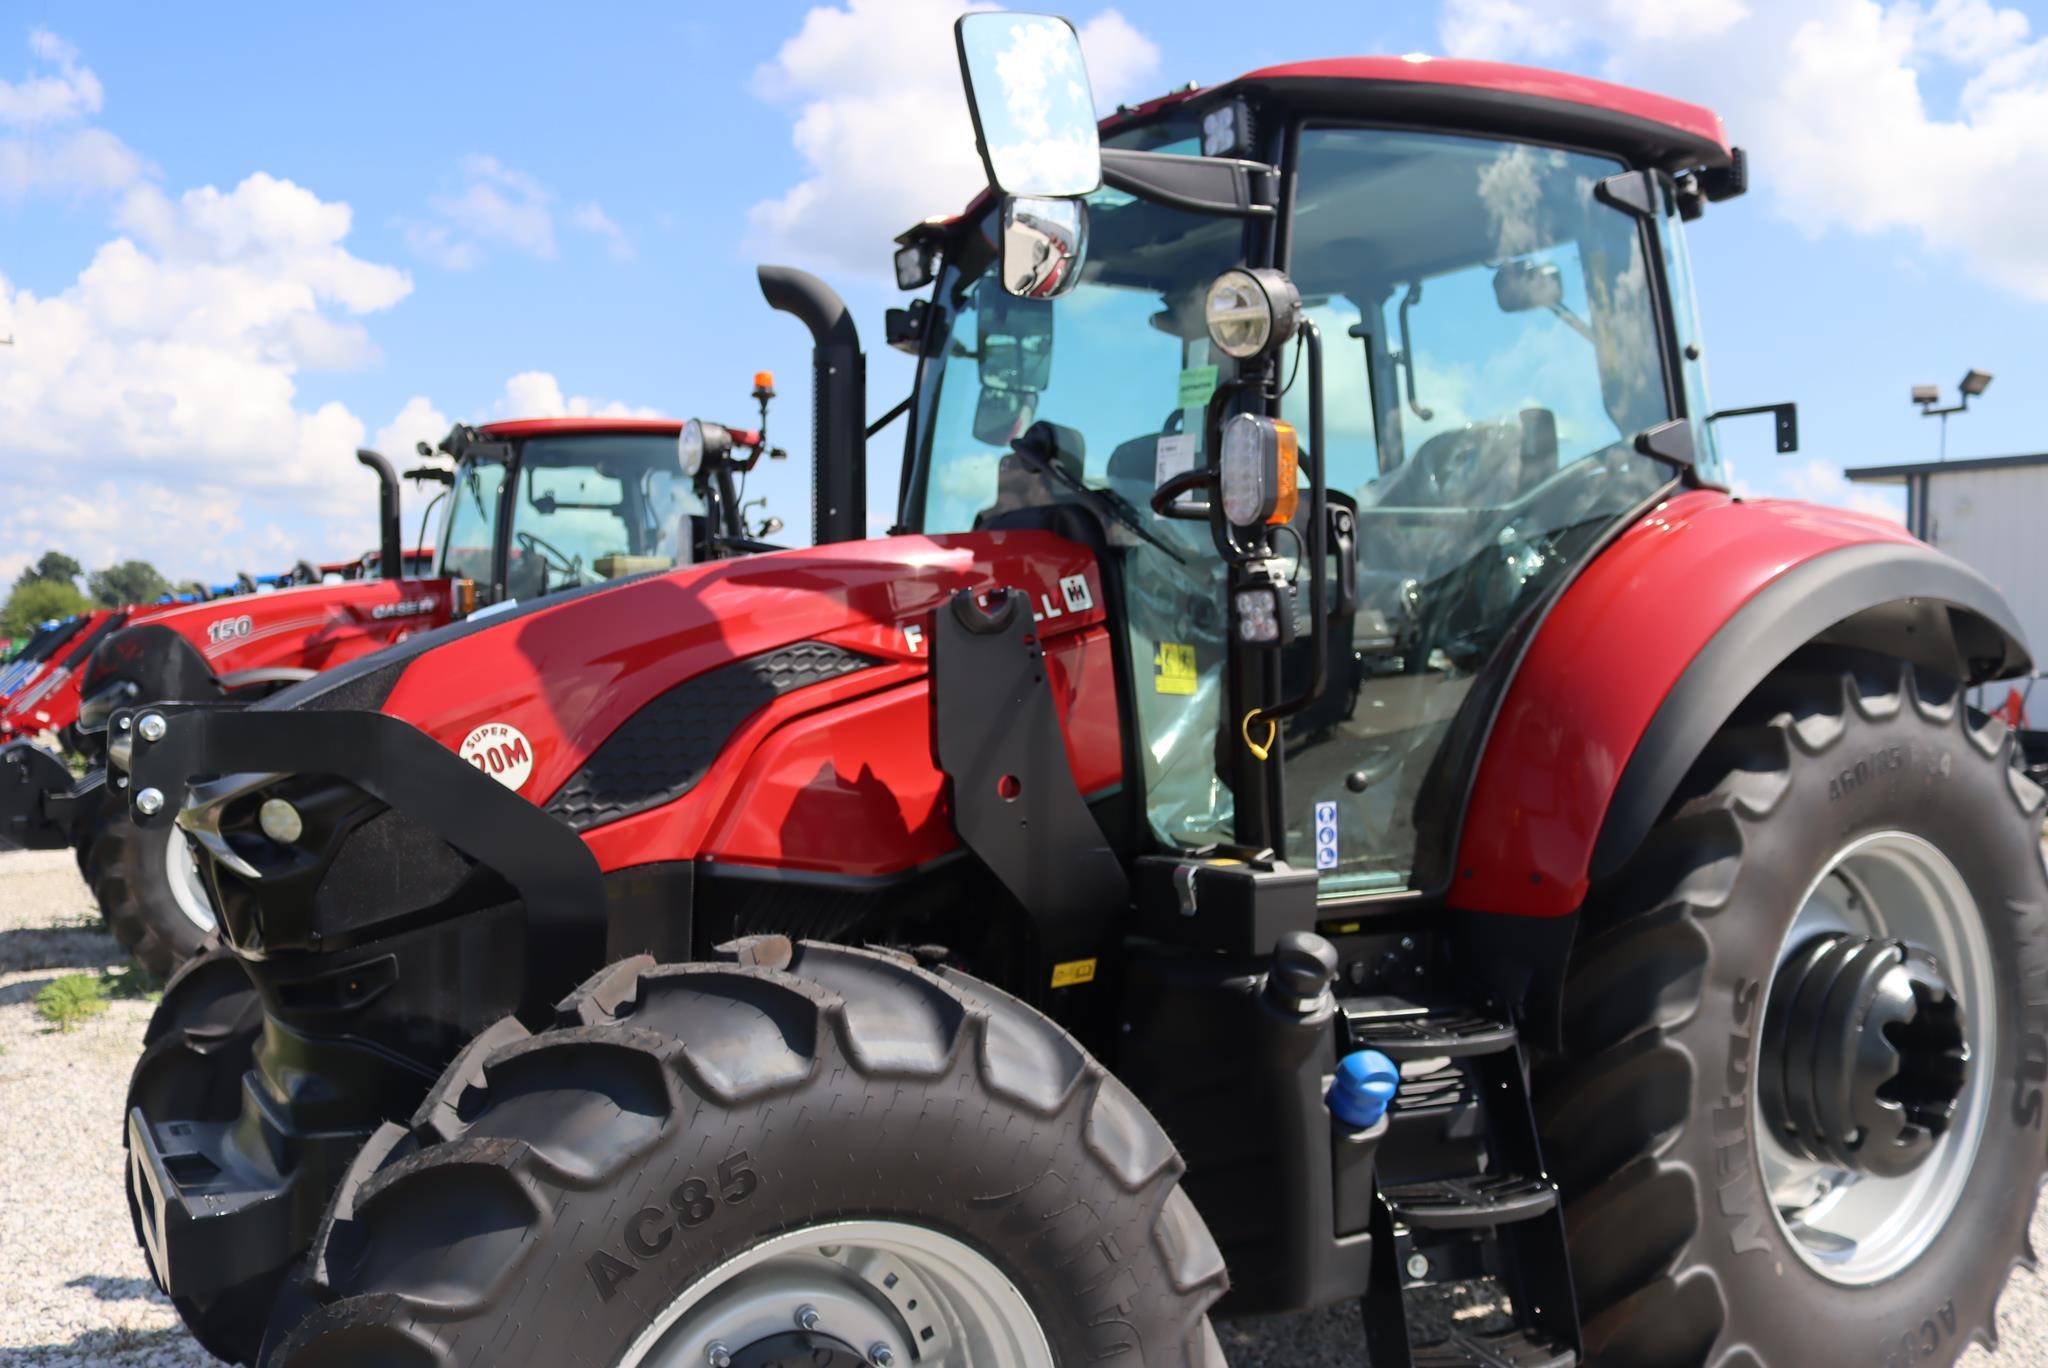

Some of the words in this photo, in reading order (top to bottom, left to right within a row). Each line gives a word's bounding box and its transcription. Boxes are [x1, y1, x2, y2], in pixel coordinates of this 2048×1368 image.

[207, 615, 252, 644] 150
[466, 727, 508, 750] SUPER
[464, 737, 529, 777] 20M
[585, 1150, 757, 1303] AC85
